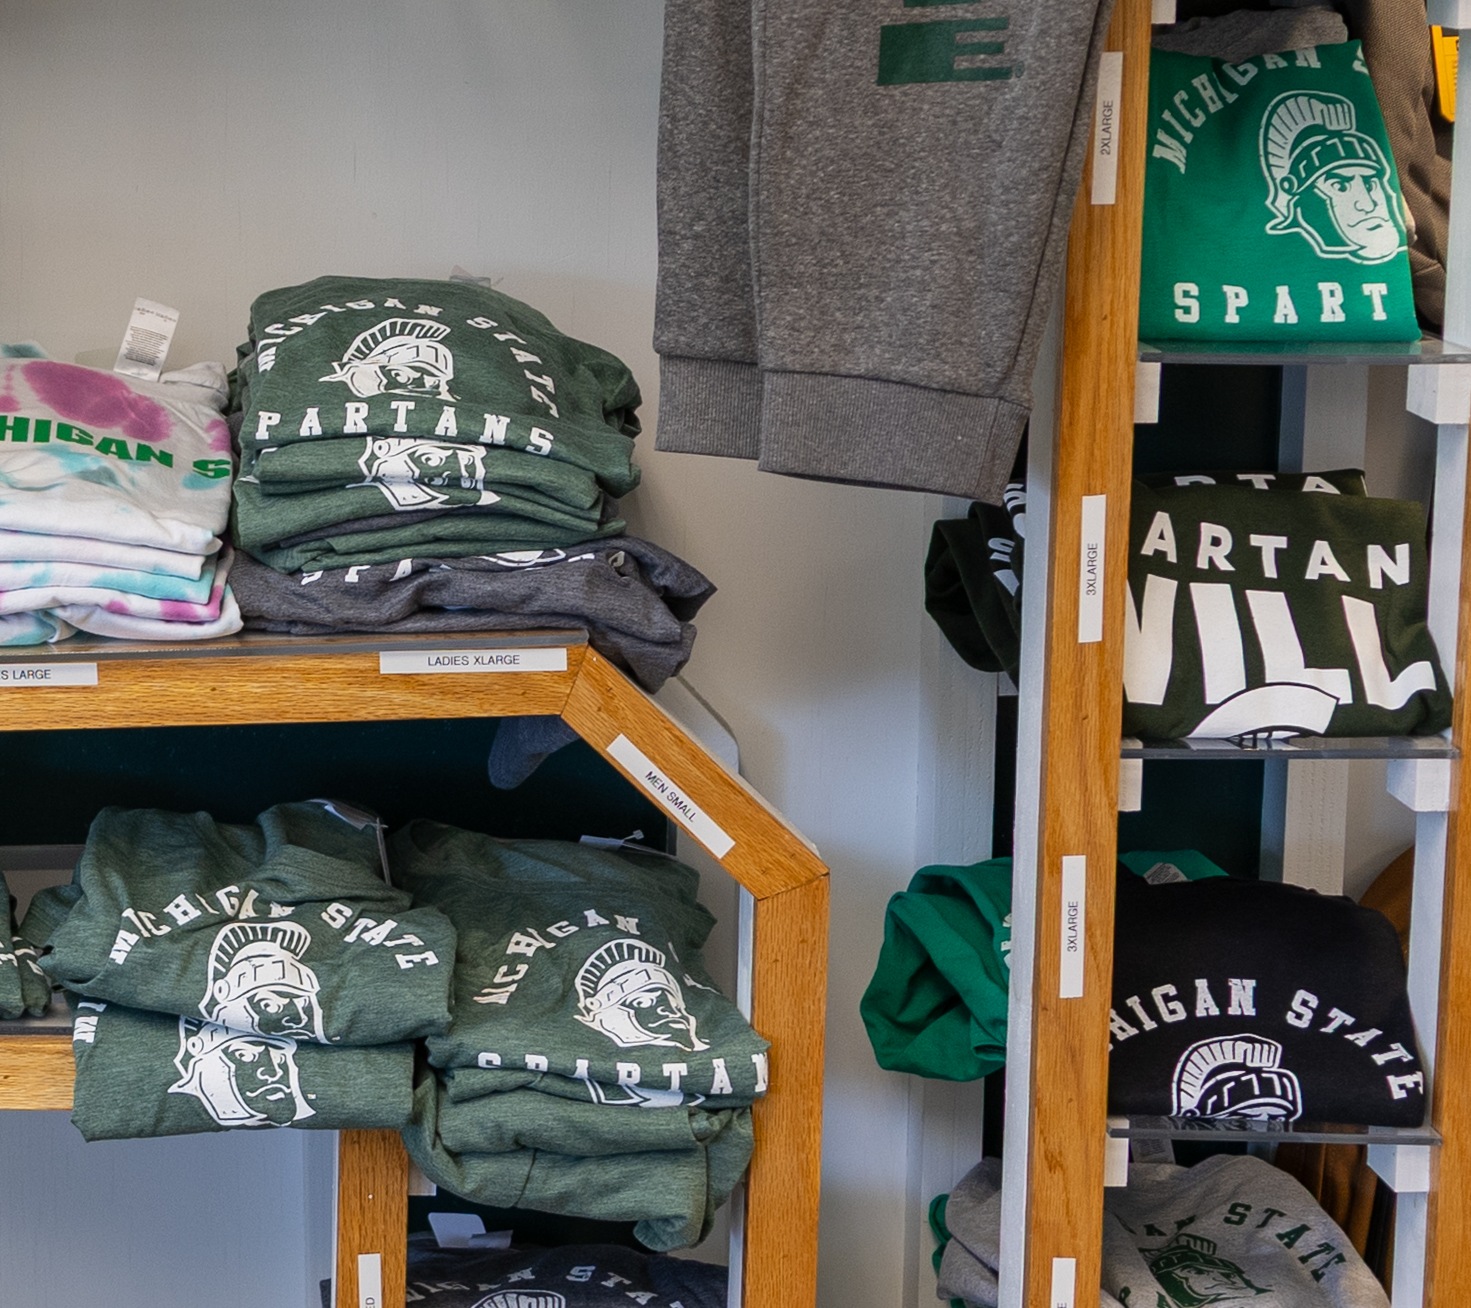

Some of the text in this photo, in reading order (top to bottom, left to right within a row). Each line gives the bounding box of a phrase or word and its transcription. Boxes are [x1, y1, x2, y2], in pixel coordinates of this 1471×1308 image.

[1099, 100, 1114, 156] 2XLARGE
[1152, 43, 1322, 174] MICHIGAN
[1173, 281, 1389, 326] SPART
[1085, 543, 1098, 596] 3XLARGE
[1141, 511, 1410, 590] ARTAN
[12, 668, 52, 680] LARGE
[427, 654, 520, 667] LADIES XLARGE
[645, 770, 696, 821] MEN SMALL
[321, 900, 439, 972] STATE
[1066, 901, 1079, 953] 3XLARGE
[1286, 989, 1424, 1101] STATE
[1223, 1202, 1349, 1283] STATE
